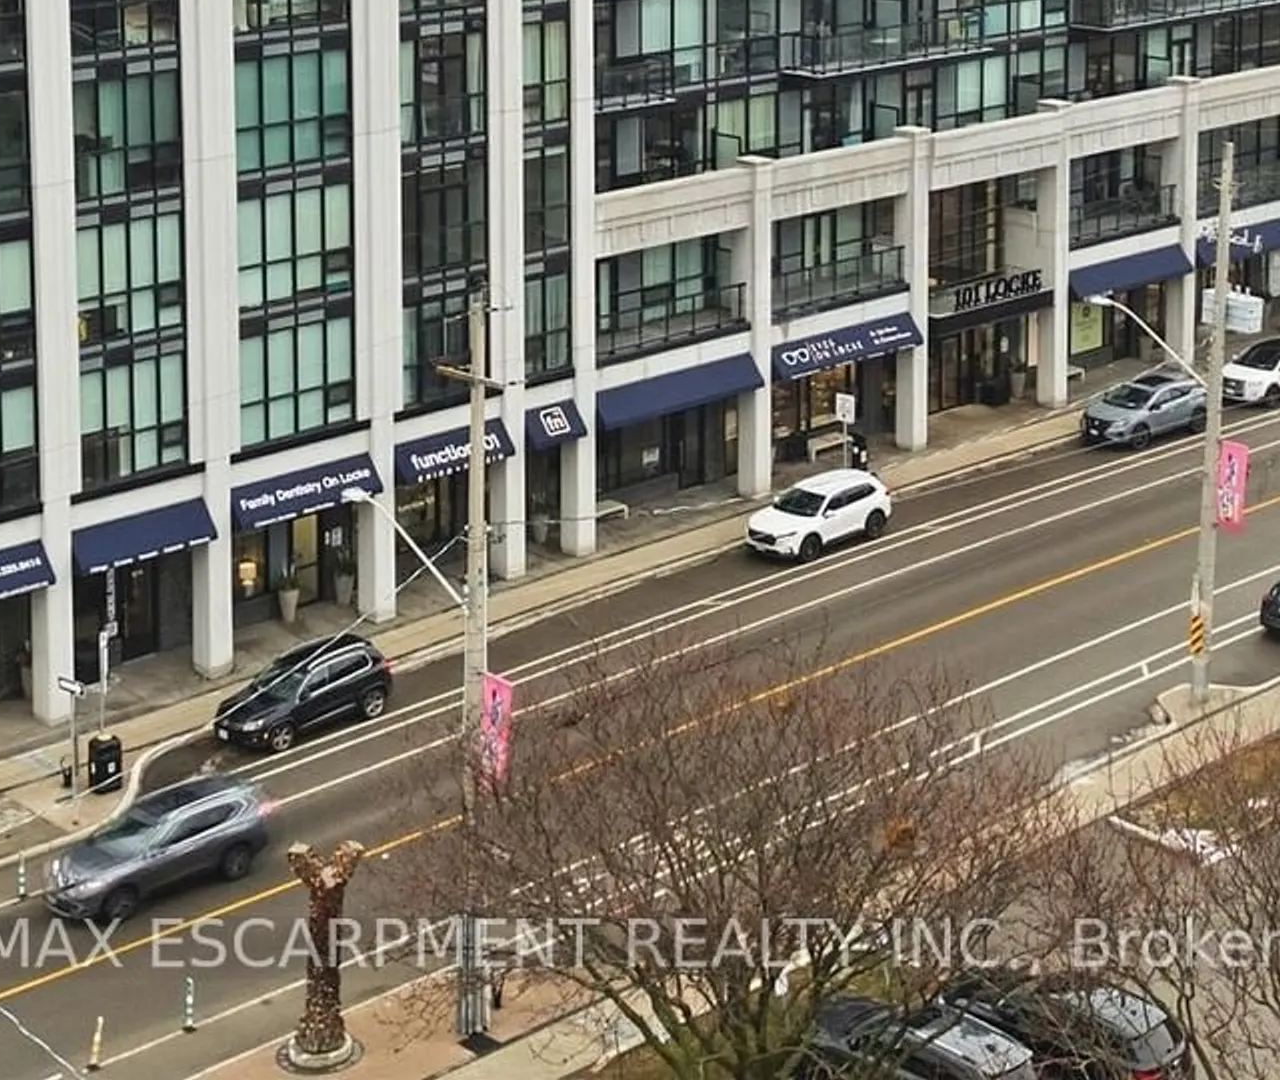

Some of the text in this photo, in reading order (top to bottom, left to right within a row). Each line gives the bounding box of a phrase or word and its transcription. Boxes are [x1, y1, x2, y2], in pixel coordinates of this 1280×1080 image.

[239, 468, 371, 511] Family Dentistry On Locke
